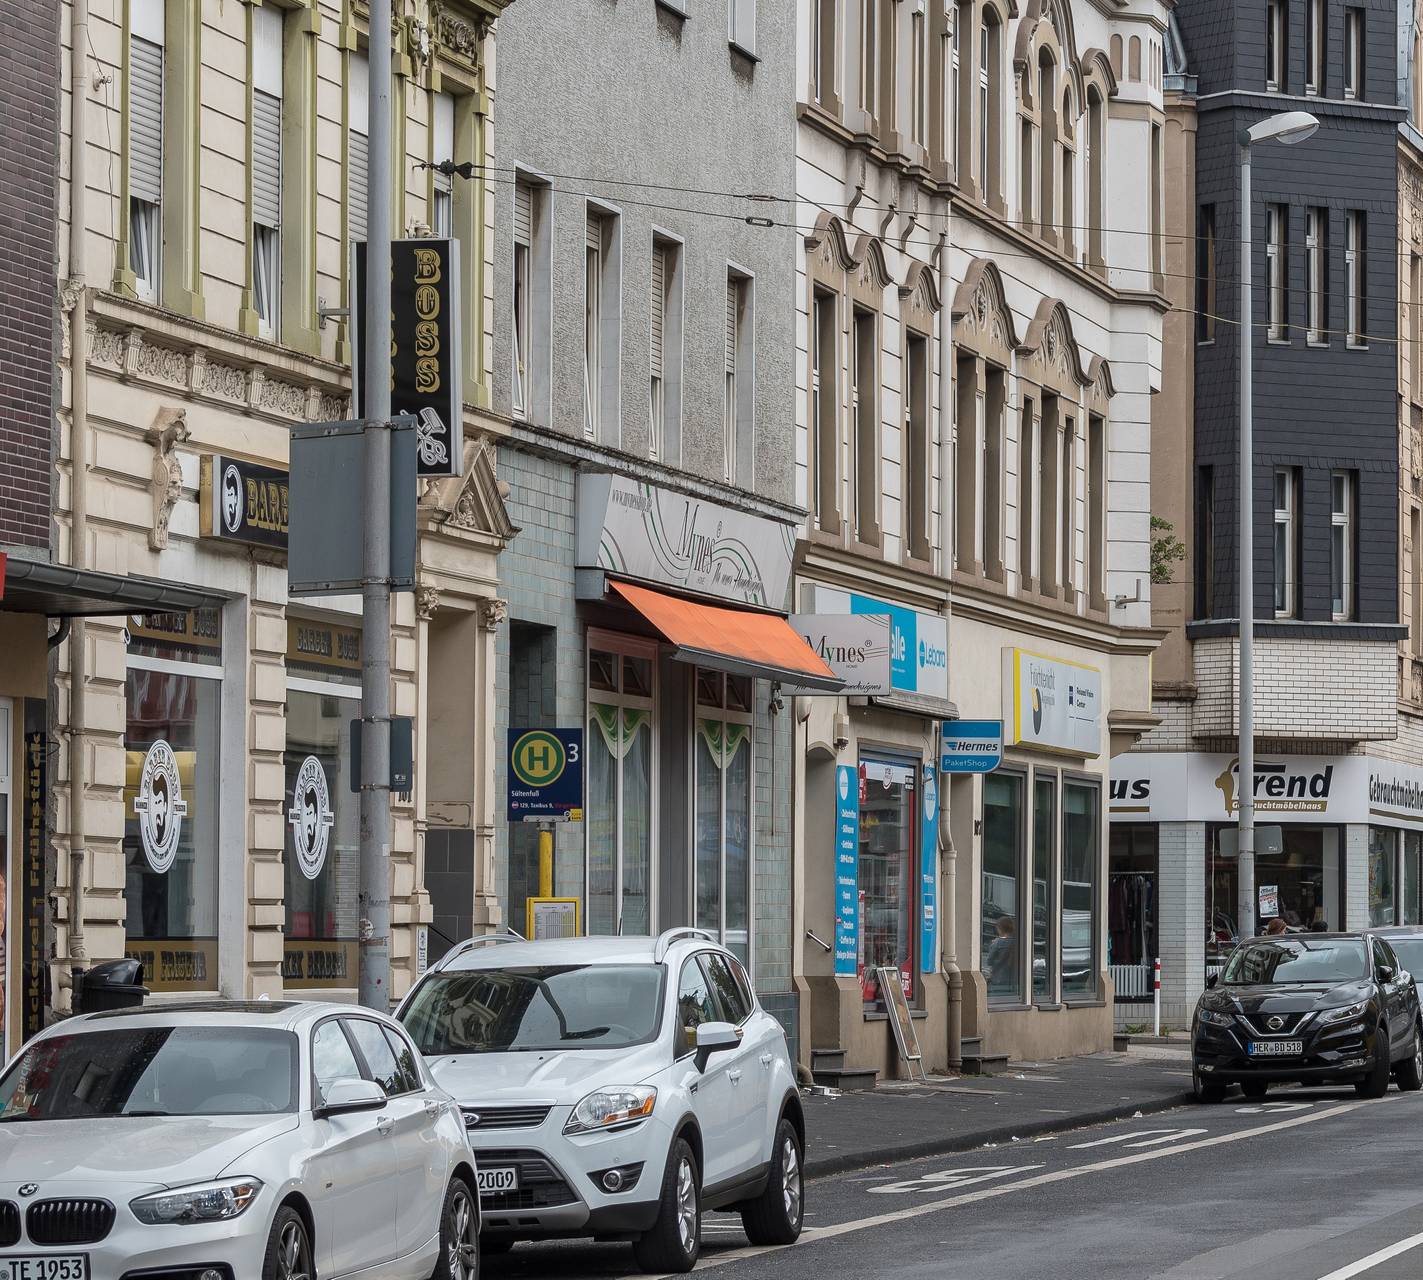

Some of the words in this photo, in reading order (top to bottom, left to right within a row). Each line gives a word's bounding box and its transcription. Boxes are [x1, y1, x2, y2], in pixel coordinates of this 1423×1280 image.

[414, 248, 441, 393] BOSS
[804, 635, 865, 668] Mynes
[567, 743, 579, 762] 3
[957, 741, 998, 751] Hermes
[944, 759, 988, 768] PaketShop
[1253, 1043, 1268, 1052] HER
[1287, 1042, 1301, 1051] 518
[478, 1171, 513, 1188] 2009
[9, 1260, 31, 1280] TE
[36, 1259, 82, 1280] 1953
